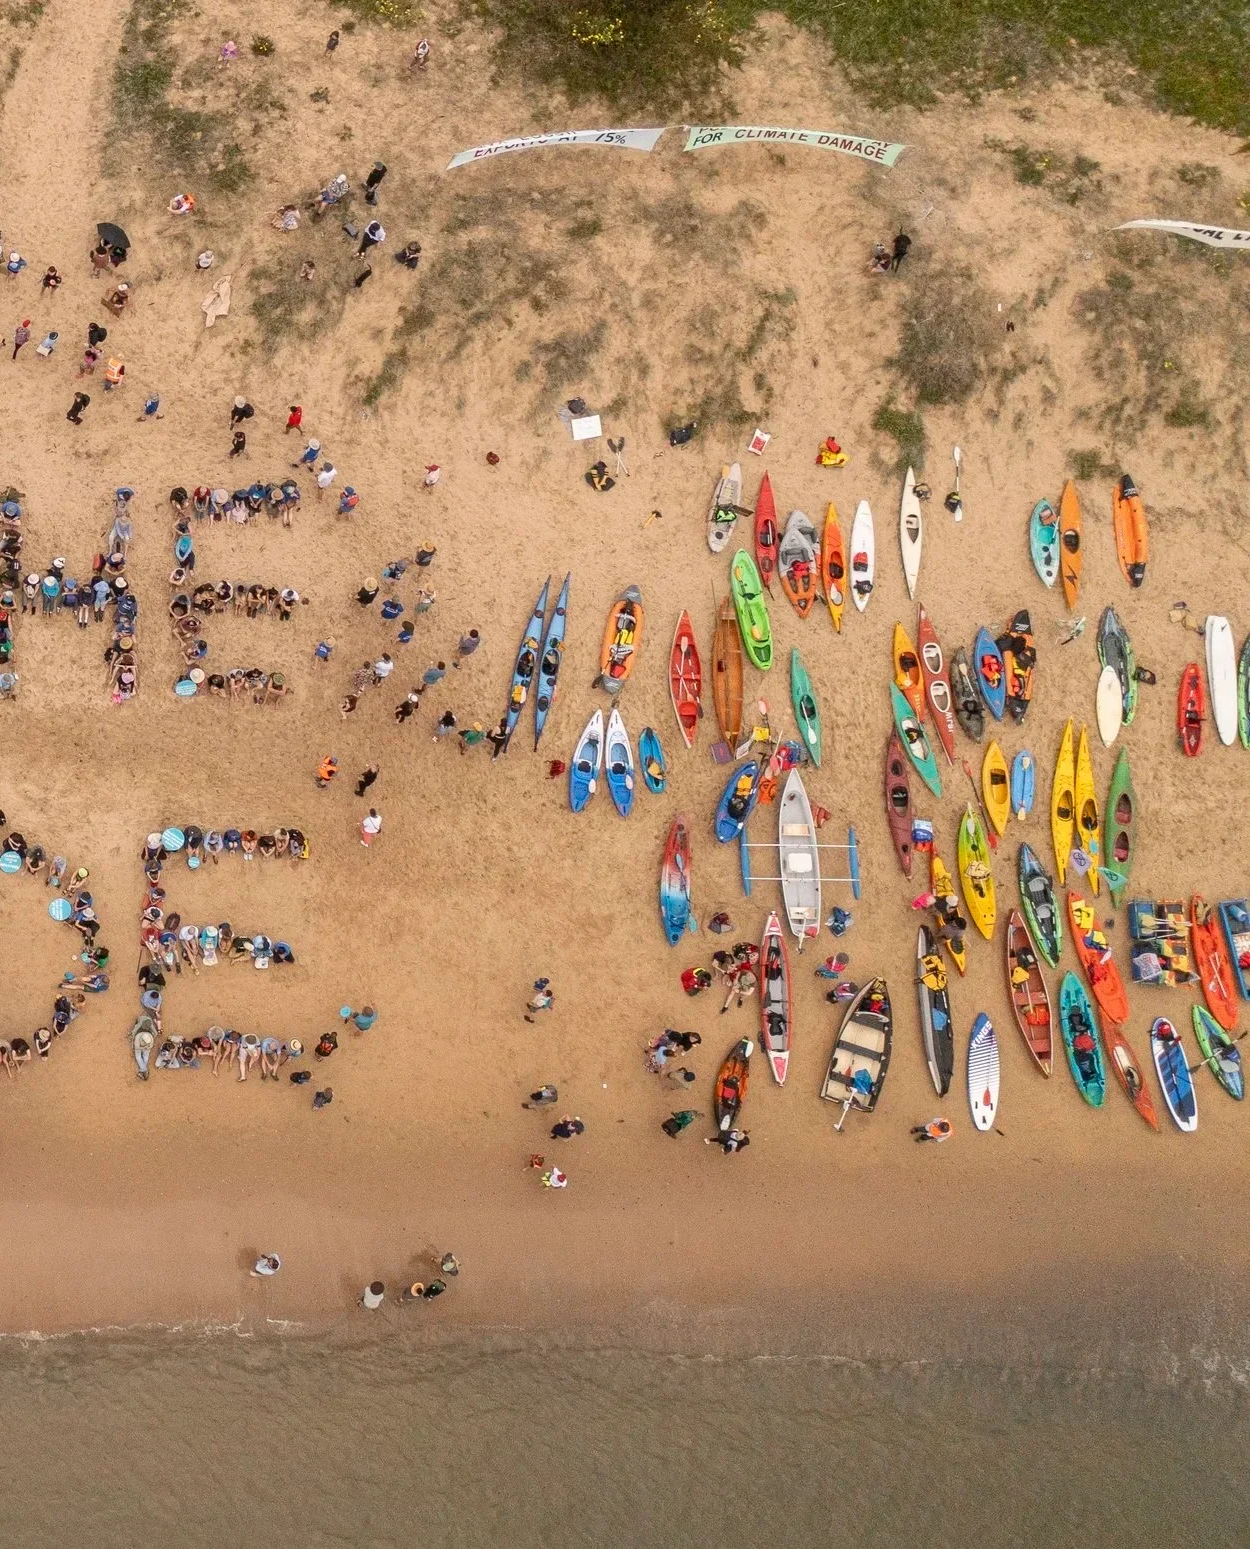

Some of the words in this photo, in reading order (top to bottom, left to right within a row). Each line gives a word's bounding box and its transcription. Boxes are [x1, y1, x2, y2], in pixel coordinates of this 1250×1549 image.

[692, 131, 722, 147] FOR
[734, 129, 809, 142] CLIMATE
[817, 134, 887, 160] DAMAGE
[971, 1020, 993, 1049] KINGS
